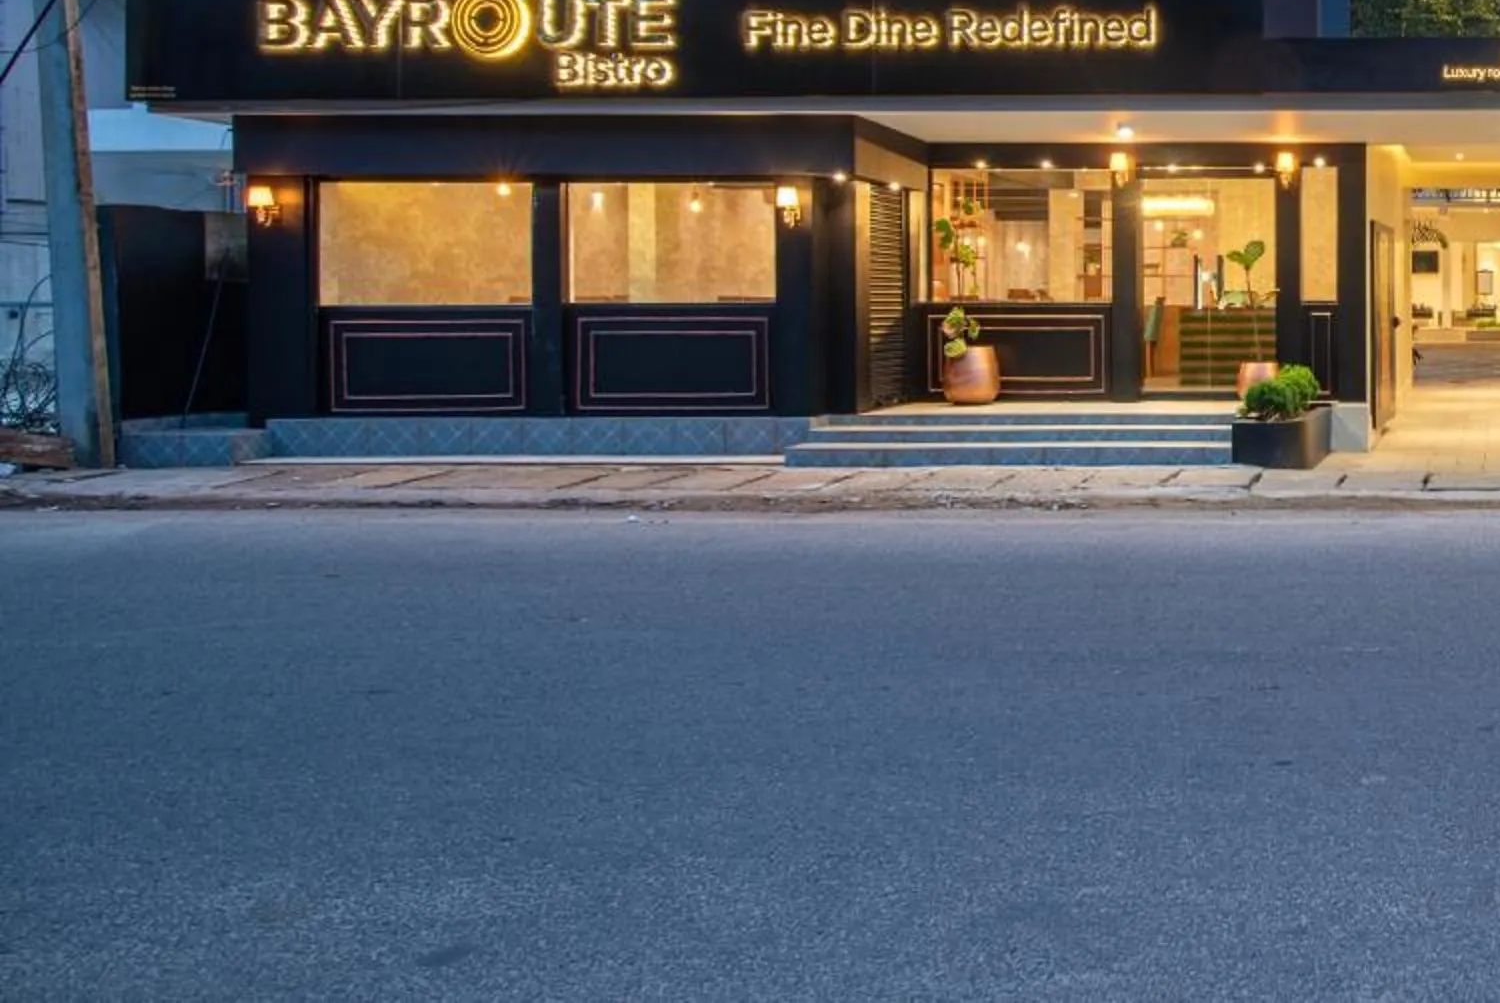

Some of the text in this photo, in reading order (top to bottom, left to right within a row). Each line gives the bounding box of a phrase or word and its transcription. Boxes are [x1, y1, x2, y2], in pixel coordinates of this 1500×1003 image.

[743, 2, 1159, 49] Fine Dine Redefined
[553, 51, 675, 88] Bistro
[1443, 64, 1487, 83] Luxury
